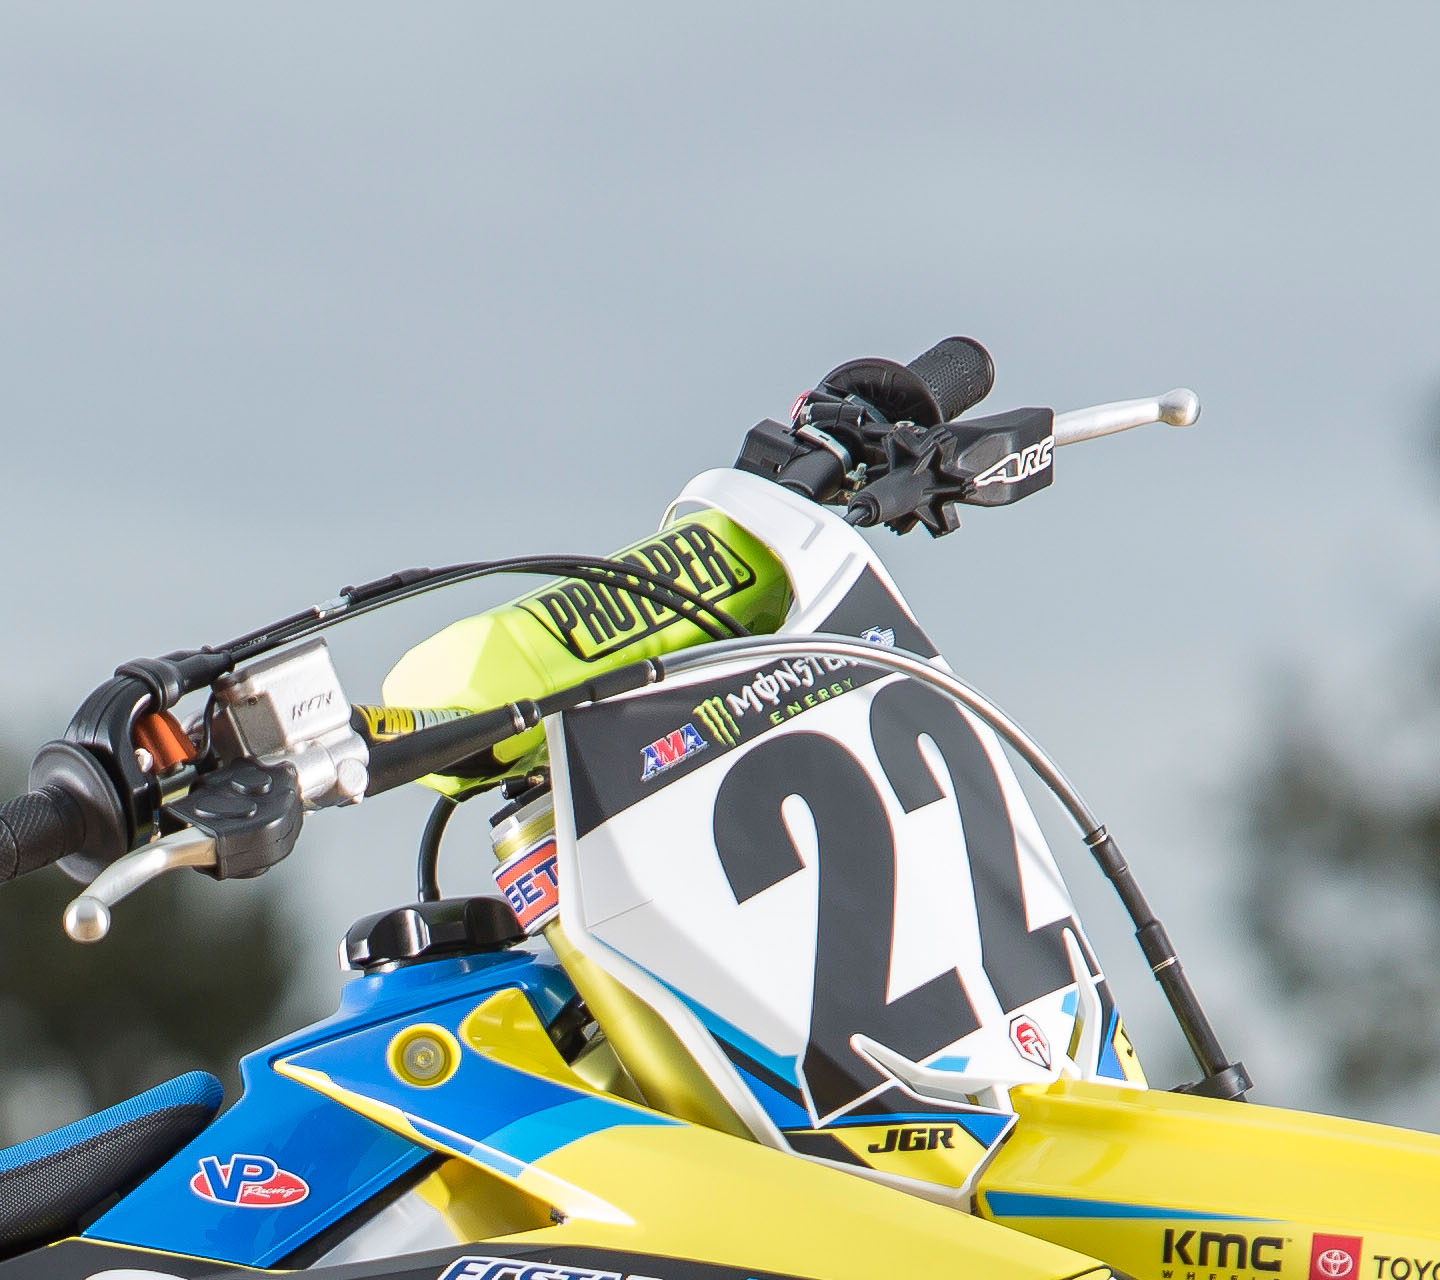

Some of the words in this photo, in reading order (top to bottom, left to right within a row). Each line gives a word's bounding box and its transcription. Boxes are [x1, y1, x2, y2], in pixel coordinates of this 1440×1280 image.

[726, 656, 858, 717] MONSTE
[771, 678, 854, 725] ENERGY
[640, 722, 708, 782] AMA
[712, 674, 1102, 1128] 22
[868, 1126, 956, 1154] JGR
[199, 1154, 278, 1206] VP
